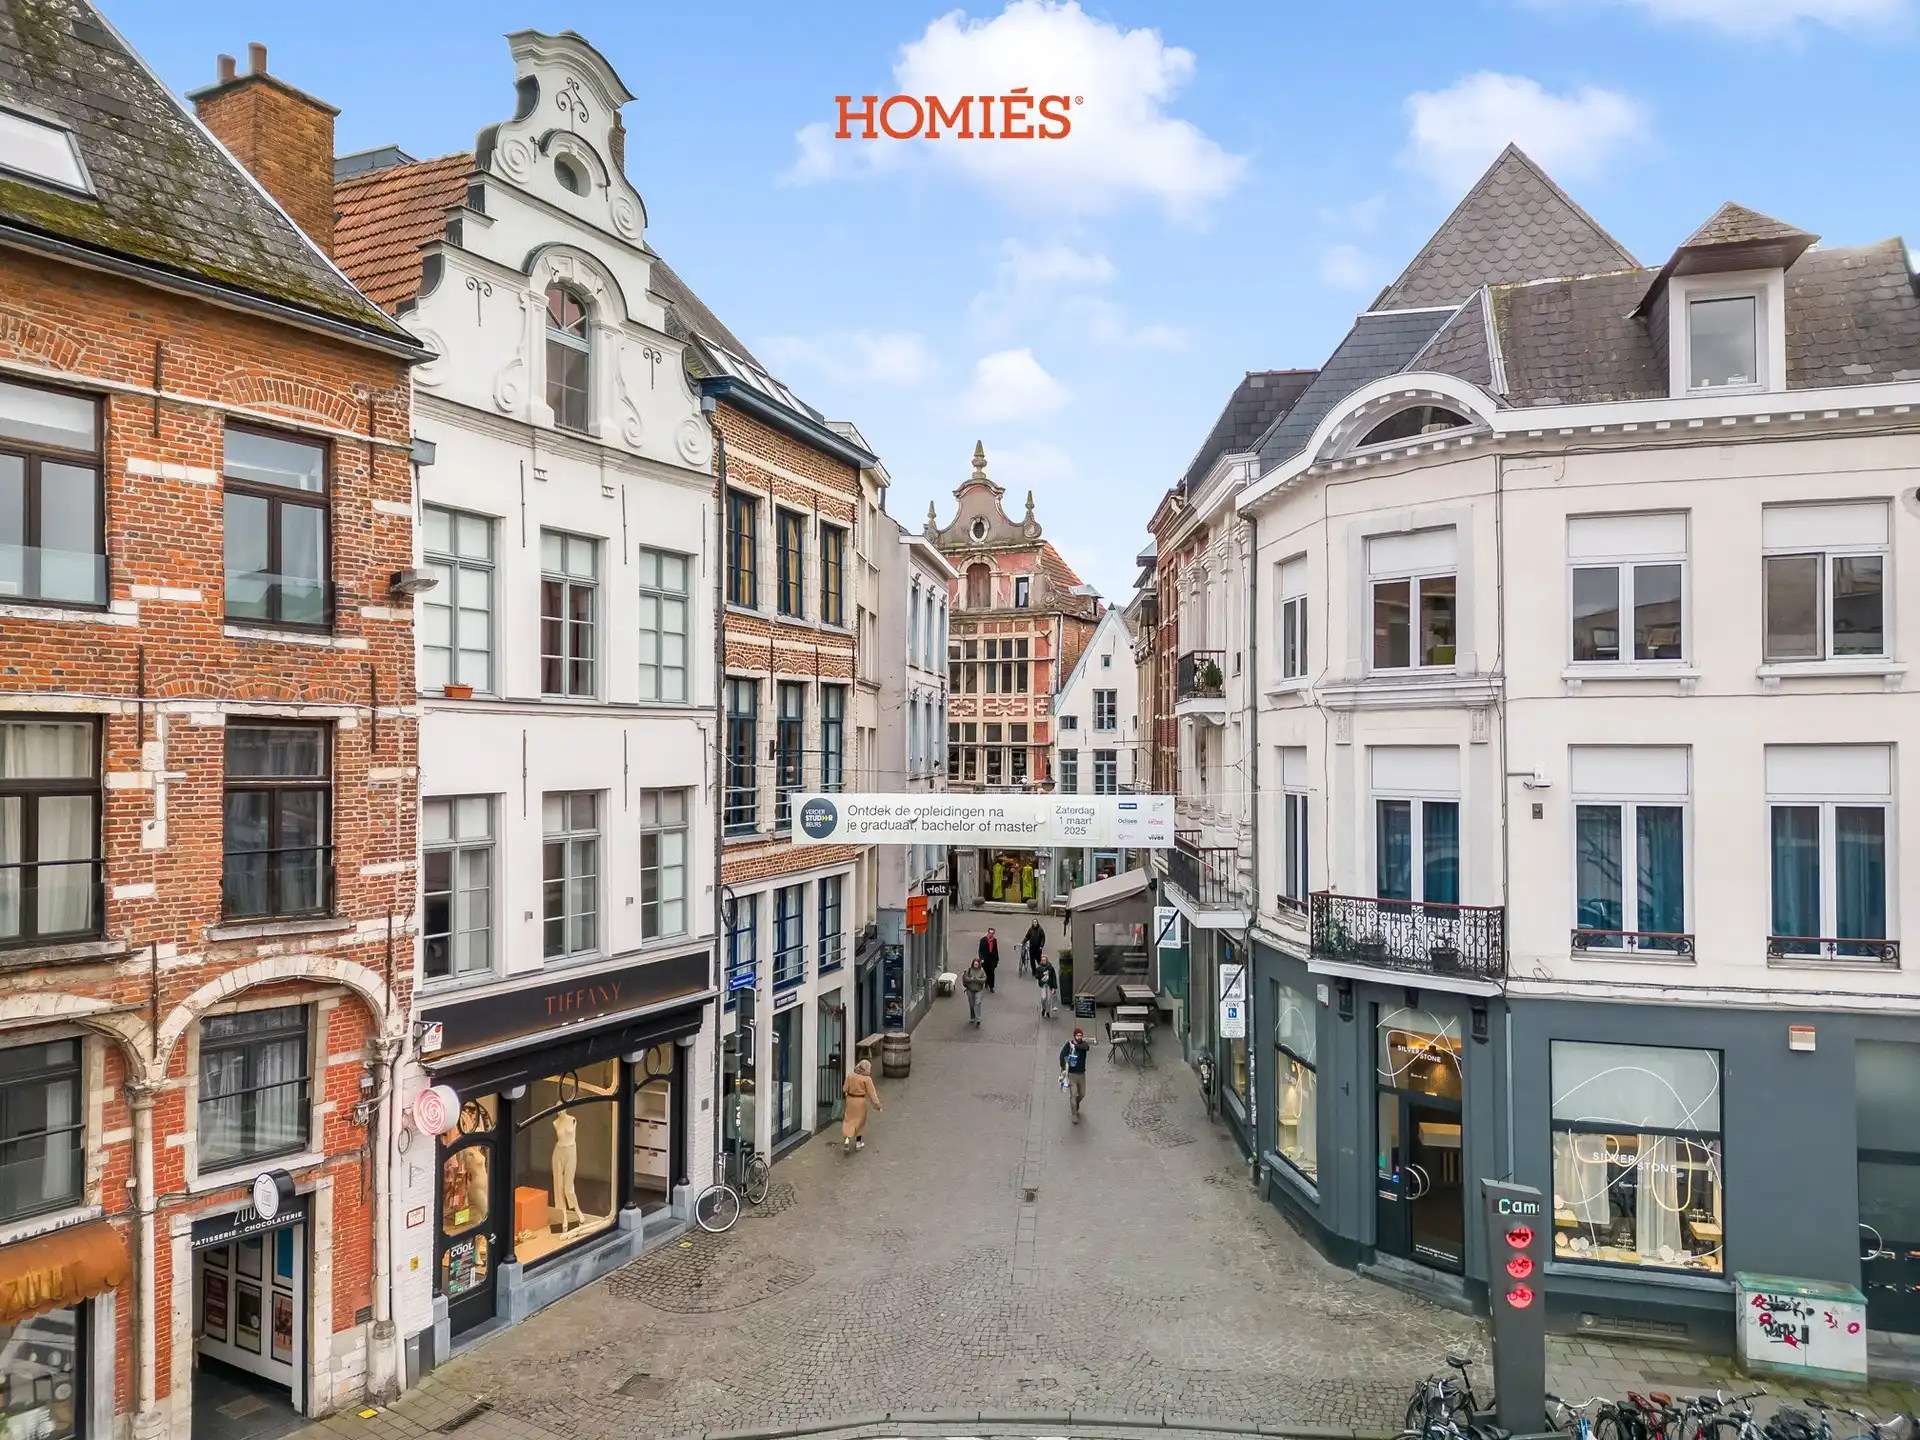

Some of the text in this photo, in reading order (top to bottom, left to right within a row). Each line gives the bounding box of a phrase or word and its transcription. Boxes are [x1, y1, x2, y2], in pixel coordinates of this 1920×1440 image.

[847, 804, 1004, 819] Ontdek de opleidingen na
[1055, 805, 1095, 816] Zaterdag
[846, 819, 857, 832] je
[921, 820, 975, 831] bachelor
[978, 820, 991, 831] of
[994, 821, 1038, 832] master
[1066, 817, 1092, 825] maart
[1064, 827, 1087, 835] 2025
[545, 980, 621, 1016] TIFFANY
[1397, 1045, 1420, 1054] SILVER
[1420, 1054, 1441, 1063] STONE
[1592, 1151, 1637, 1163] SILVER
[1637, 1161, 1677, 1174] STONE
[234, 1206, 262, 1226] ZUU
[191, 1229, 237, 1247] PATISSERIE
[244, 1211, 303, 1232] CHOCOLATERIE
[451, 1242, 475, 1258] COOL
